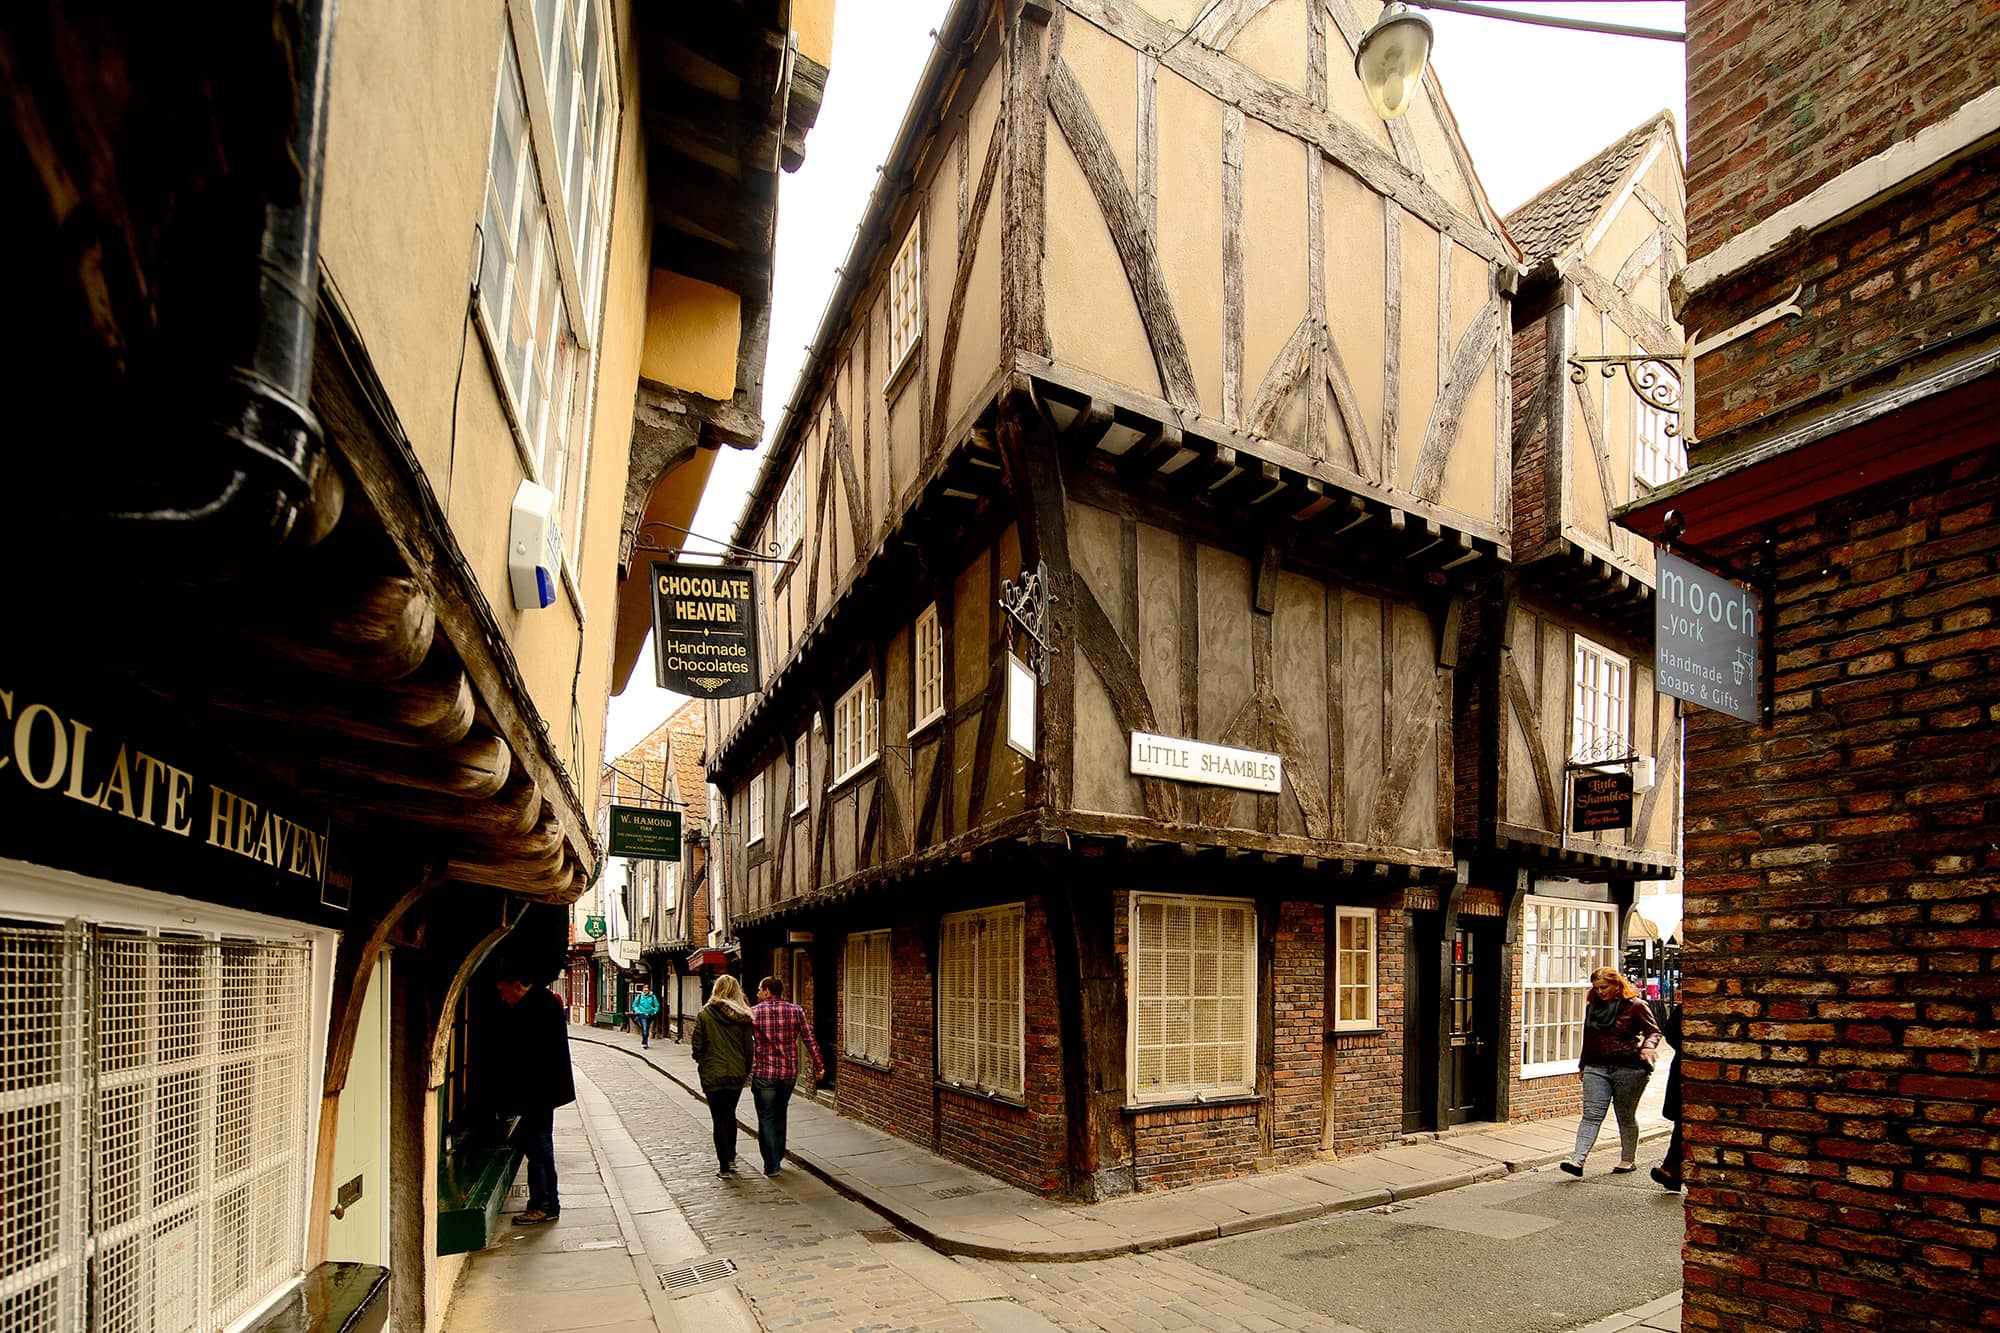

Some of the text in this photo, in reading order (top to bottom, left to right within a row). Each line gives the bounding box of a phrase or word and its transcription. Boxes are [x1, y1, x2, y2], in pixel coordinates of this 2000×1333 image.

[659, 575, 750, 600] CHOCOLATE
[675, 601, 737, 622] HEAVEN
[1661, 568, 1754, 638] mooch
[667, 640, 747, 657] Handmade
[667, 657, 749, 673] Chocolates
[1660, 648, 1722, 684] Handmade
[1660, 670, 1739, 711] Soaps & Gifts
[1138, 743, 1276, 781] LITTLE SHAMBLES
[1588, 778, 1617, 794] Little
[1576, 791, 1630, 808] Shambles
[620, 813, 672, 828] W. HAMOND
[206, 784, 326, 882] HEAVEN
